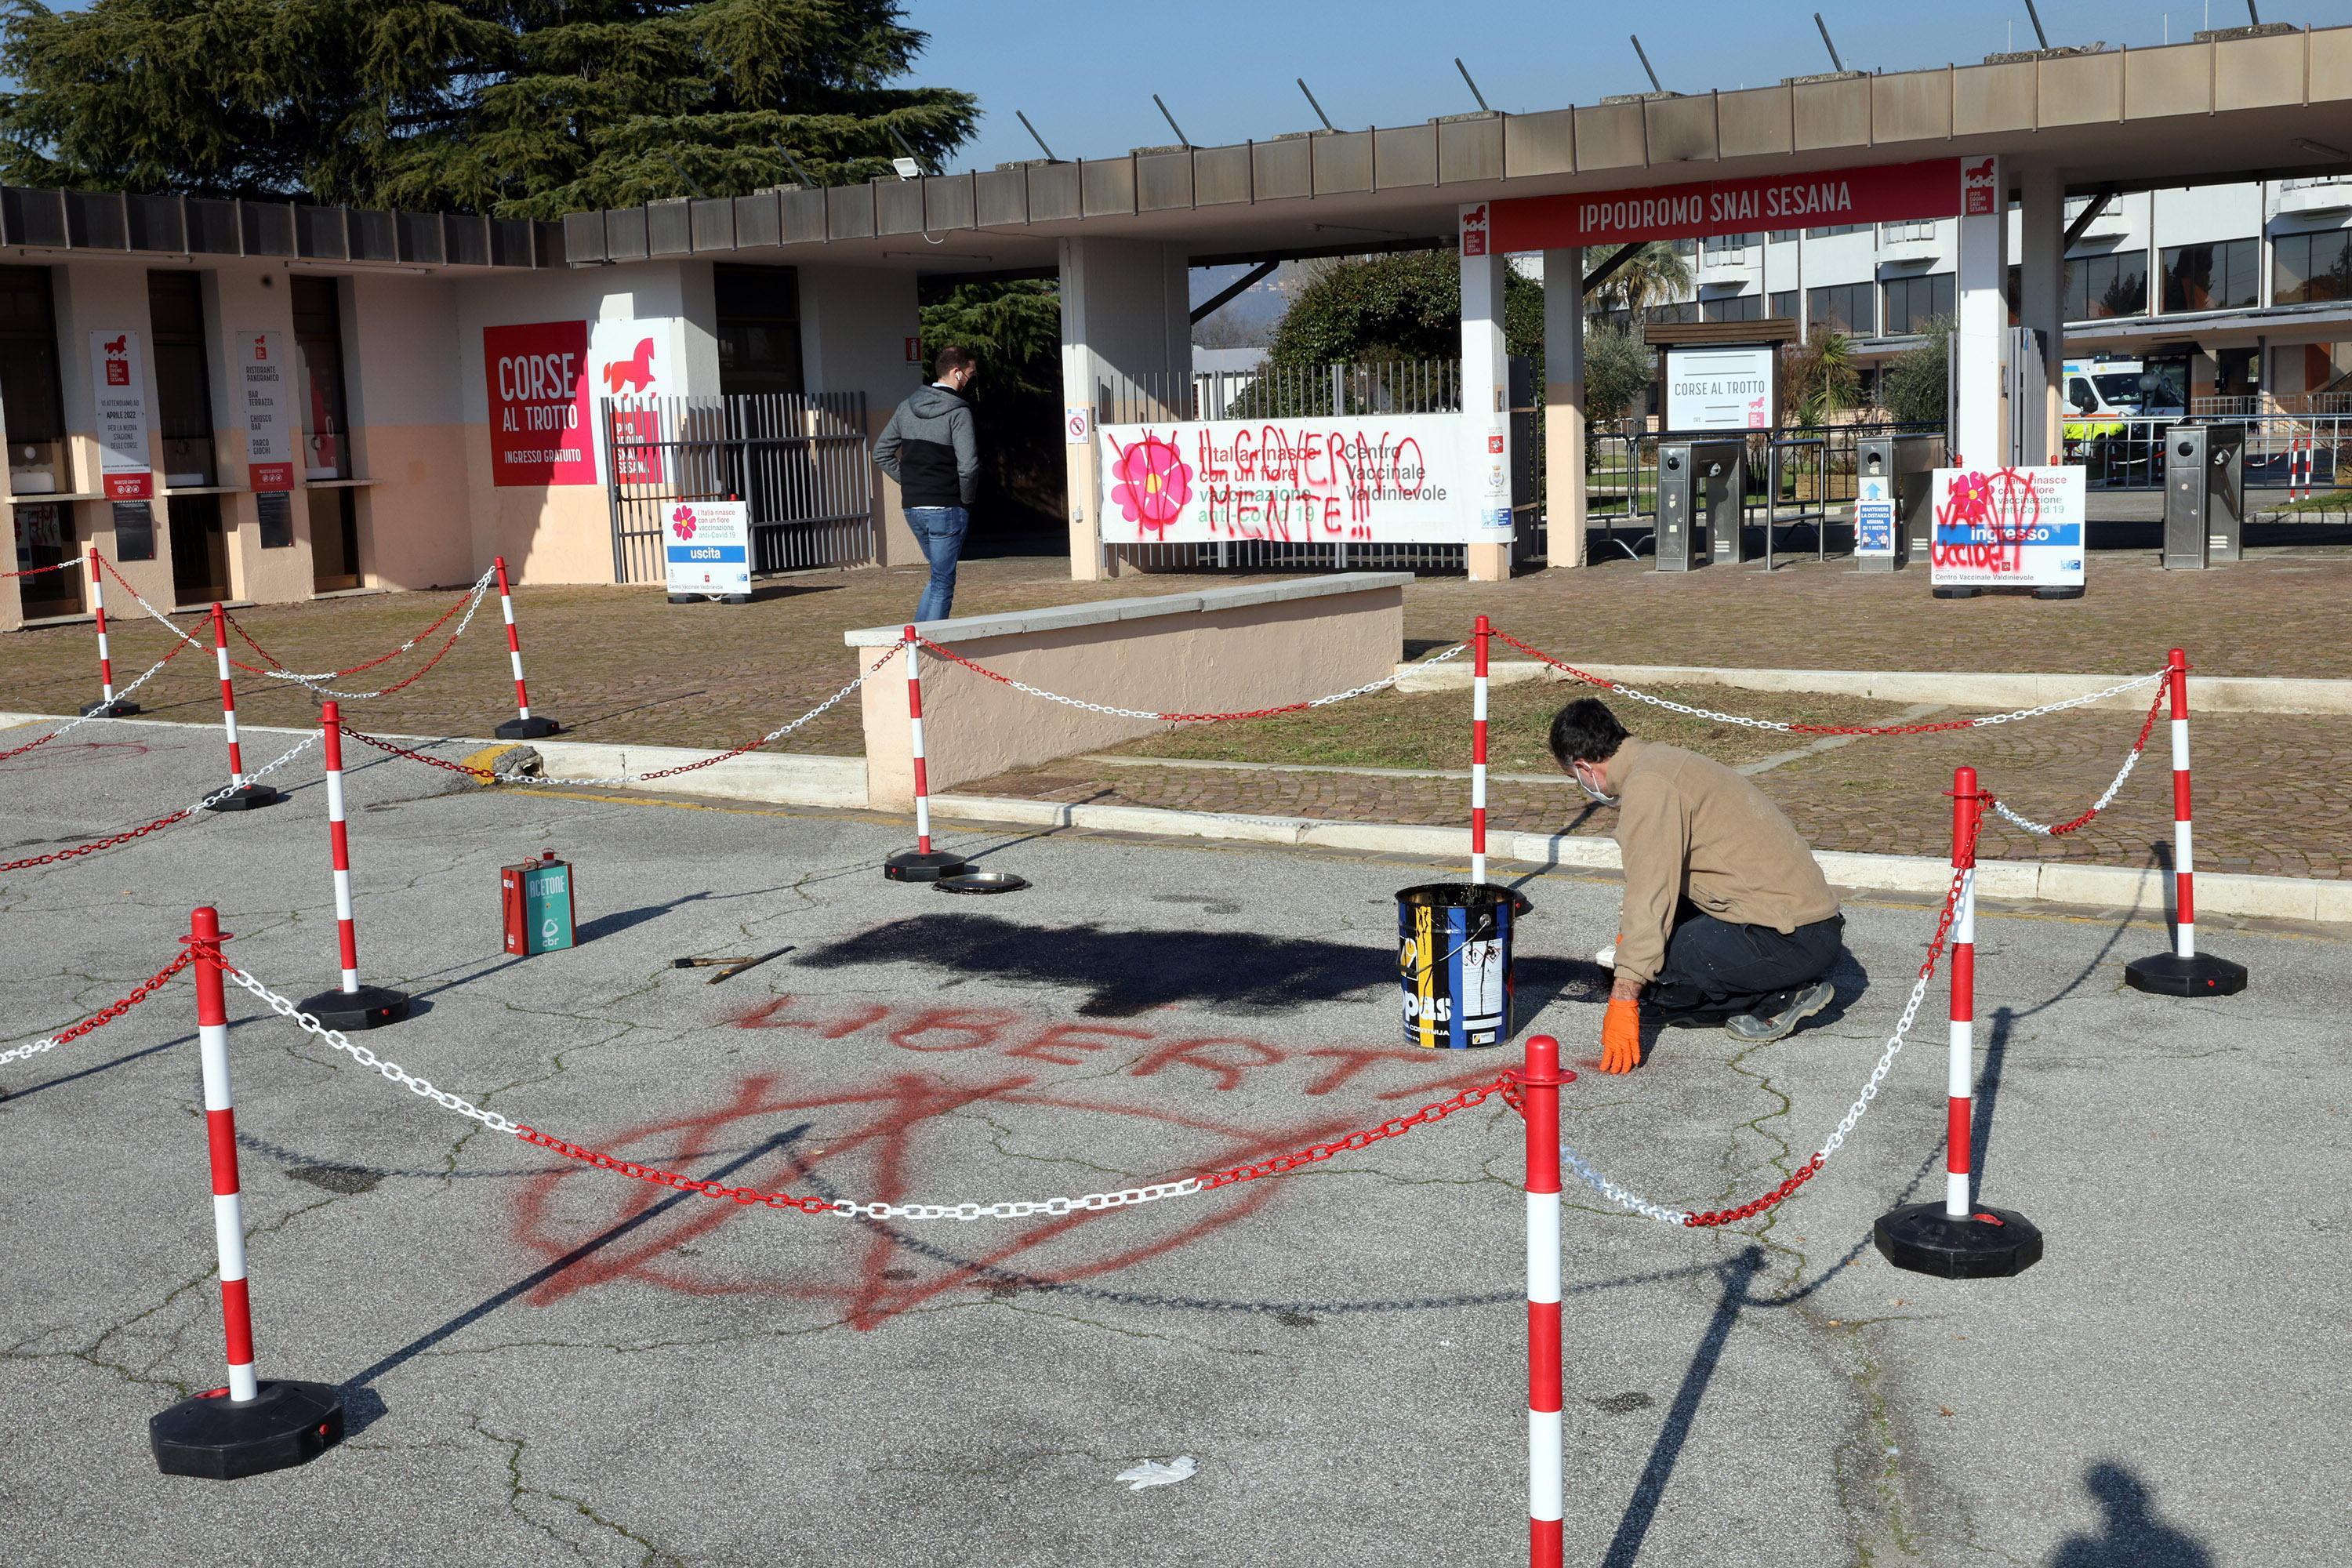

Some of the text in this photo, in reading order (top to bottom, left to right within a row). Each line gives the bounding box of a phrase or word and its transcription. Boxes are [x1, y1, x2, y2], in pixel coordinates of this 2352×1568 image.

[1579, 181, 1853, 233] IPPODROMO SNAI SESANA
[246, 365, 276, 374] RISTORANTE
[498, 353, 577, 401] CORSE
[1675, 380, 1765, 396] CORSE AL TROTTO
[503, 404, 578, 431] AL TROTTO
[504, 448, 582, 464] INGRESSO GRATUITO
[1254, 445, 1317, 462] rinasce
[1345, 443, 1402, 459] Centro
[1235, 425, 1424, 496] GOVERNO
[1200, 470, 1229, 483] con
[1234, 470, 1255, 482] un
[1346, 463, 1426, 480] Vaccinale
[1200, 485, 1312, 502] vaccinazione
[1345, 485, 1447, 501] Valdinievole
[1998, 495, 2063, 504] vaccinazione
[1295, 506, 1315, 522] 19
[1998, 505, 2065, 514] anti-Covid 19
[1970, 526, 2049, 544] ingresso
[690, 546, 721, 559] uscita
[529, 875, 565, 898] ACETONE
[542, 937, 560, 947] cbr
[1409, 1025, 1450, 1036] CONTINUA
